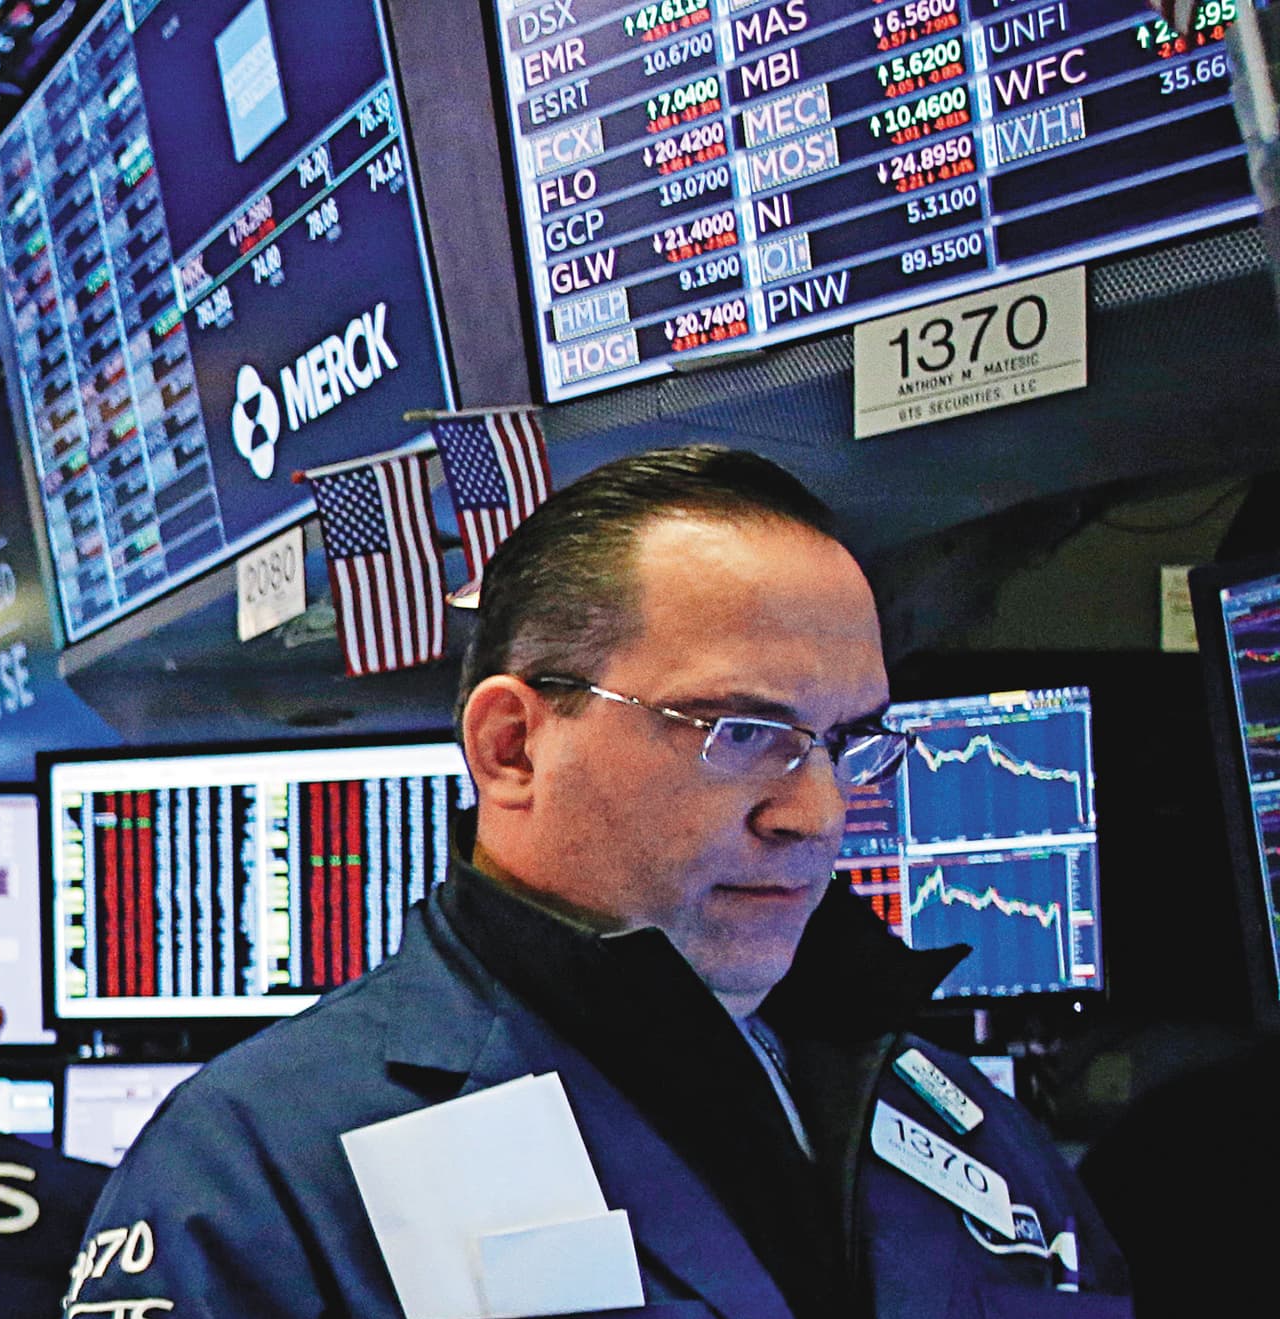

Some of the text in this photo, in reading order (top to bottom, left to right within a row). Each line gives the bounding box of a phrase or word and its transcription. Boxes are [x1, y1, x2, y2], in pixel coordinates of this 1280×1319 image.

[518, 0, 577, 45] DSX
[735, 0, 808, 52] MAS
[740, 0, 955, 98] MBI 6.5600
[988, 2, 1066, 53] UNFI
[523, 38, 587, 87] EMR
[529, 32, 713, 125] ESRT 10.6700
[891, 39, 961, 82] 5.6200
[994, 48, 1088, 106] WFC
[1160, 55, 1229, 95] 35.66
[533, 123, 593, 171] FCX
[658, 77, 719, 117] 7.0400
[885, 86, 966, 134] 10.4600
[541, 168, 597, 213] FLO
[654, 122, 725, 164] 20.4200
[757, 136, 972, 233] NI 24.8950
[907, 185, 977, 224] 5.3100
[546, 166, 729, 252] GCP 19.0700
[551, 247, 616, 294] GLW
[664, 210, 735, 250] 21.4000
[768, 234, 982, 323] PNW 89.5500
[559, 255, 740, 330] HMLP 9.1900
[676, 299, 746, 338] 20.7400
[279, 301, 399, 432] MERCK
[888, 293, 1048, 380] 1370
[897, 373, 954, 397] ANTHONY
[890, 1117, 989, 1194] 1370
